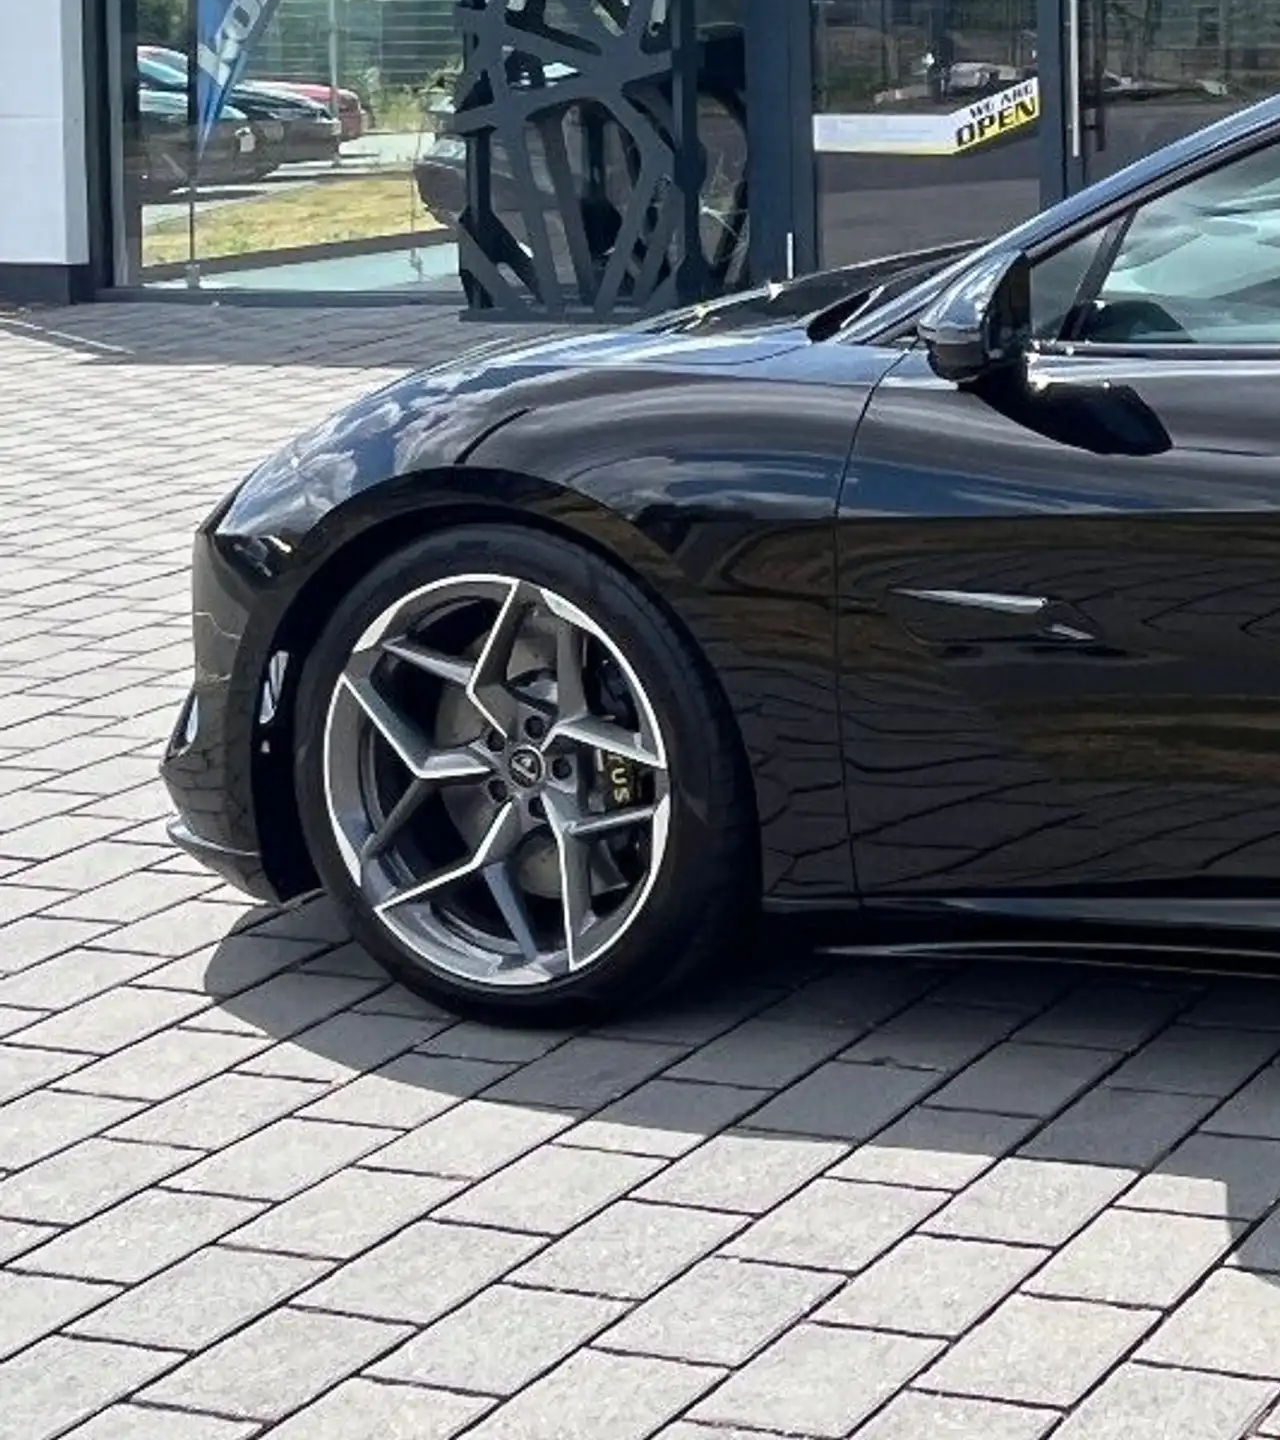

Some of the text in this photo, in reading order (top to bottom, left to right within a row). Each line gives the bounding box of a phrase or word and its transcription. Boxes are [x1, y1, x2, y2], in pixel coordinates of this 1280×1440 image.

[956, 96, 1037, 147] OPEN
[969, 84, 1034, 118] WE ARE
[607, 754, 630, 805] TUS
